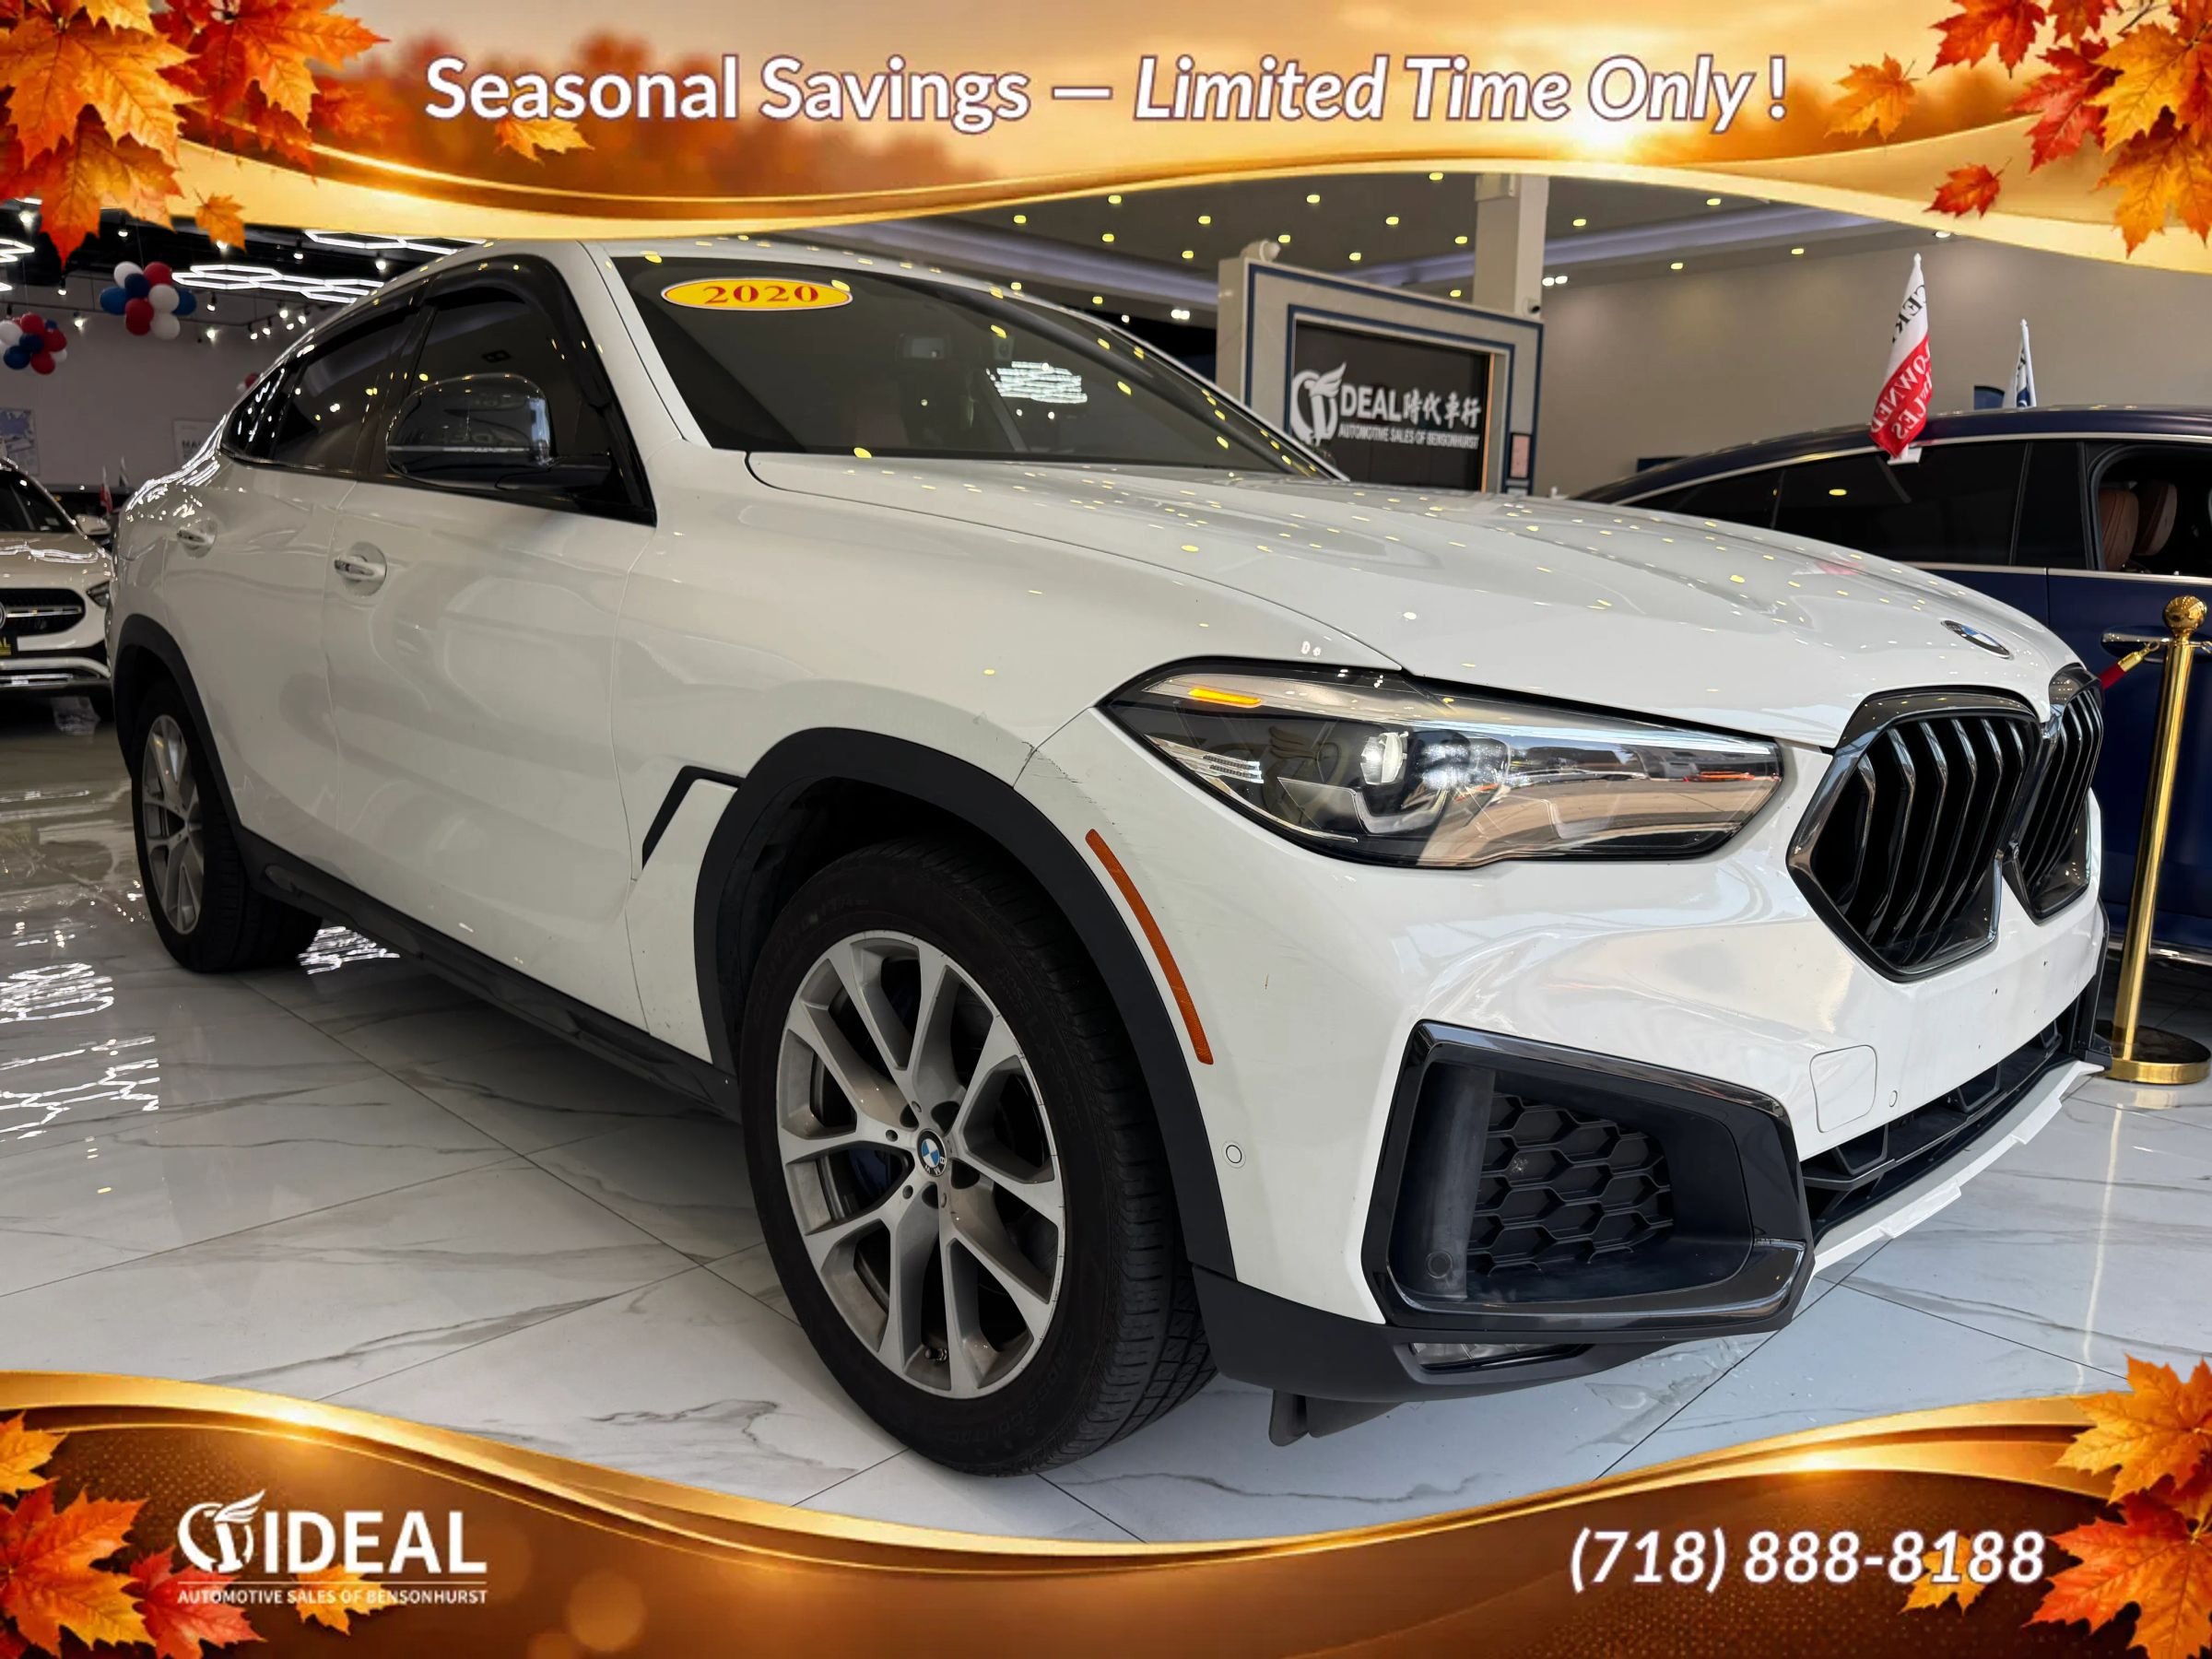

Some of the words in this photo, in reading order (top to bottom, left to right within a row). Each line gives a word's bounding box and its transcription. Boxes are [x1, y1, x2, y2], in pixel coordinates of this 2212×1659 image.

[703, 285, 819, 305] 2020
[1338, 423, 1389, 442] AUTOMOTIVE
[1390, 426, 1415, 444] SALES
[1415, 429, 1427, 445] OF
[1426, 430, 1480, 451] BENSONHURST
